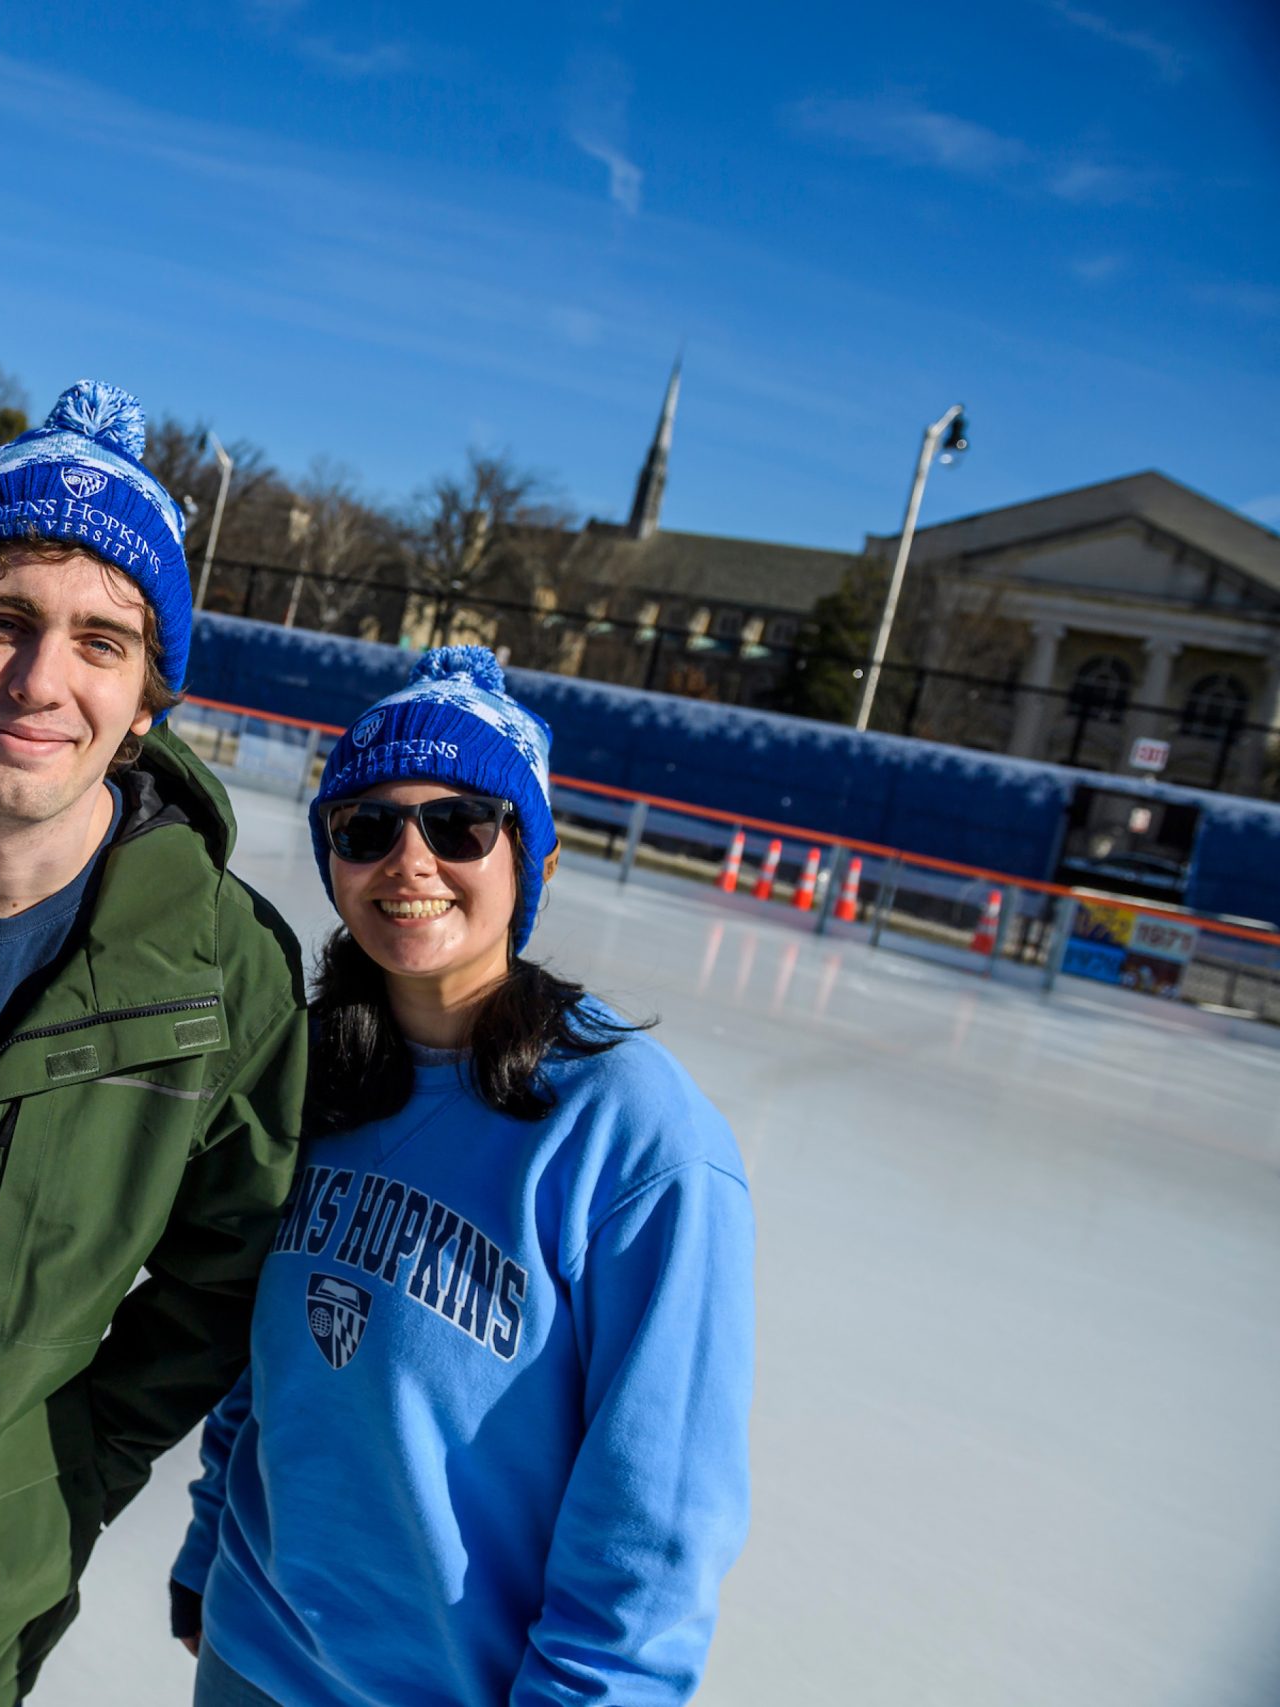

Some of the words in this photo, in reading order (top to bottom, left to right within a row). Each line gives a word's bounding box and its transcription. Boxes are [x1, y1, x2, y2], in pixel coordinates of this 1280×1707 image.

[0, 519, 140, 566] UVERSITY
[63, 498, 161, 575] HOPKINS
[271, 1165, 356, 1256] NS
[333, 1172, 528, 1364] HOPKINS
